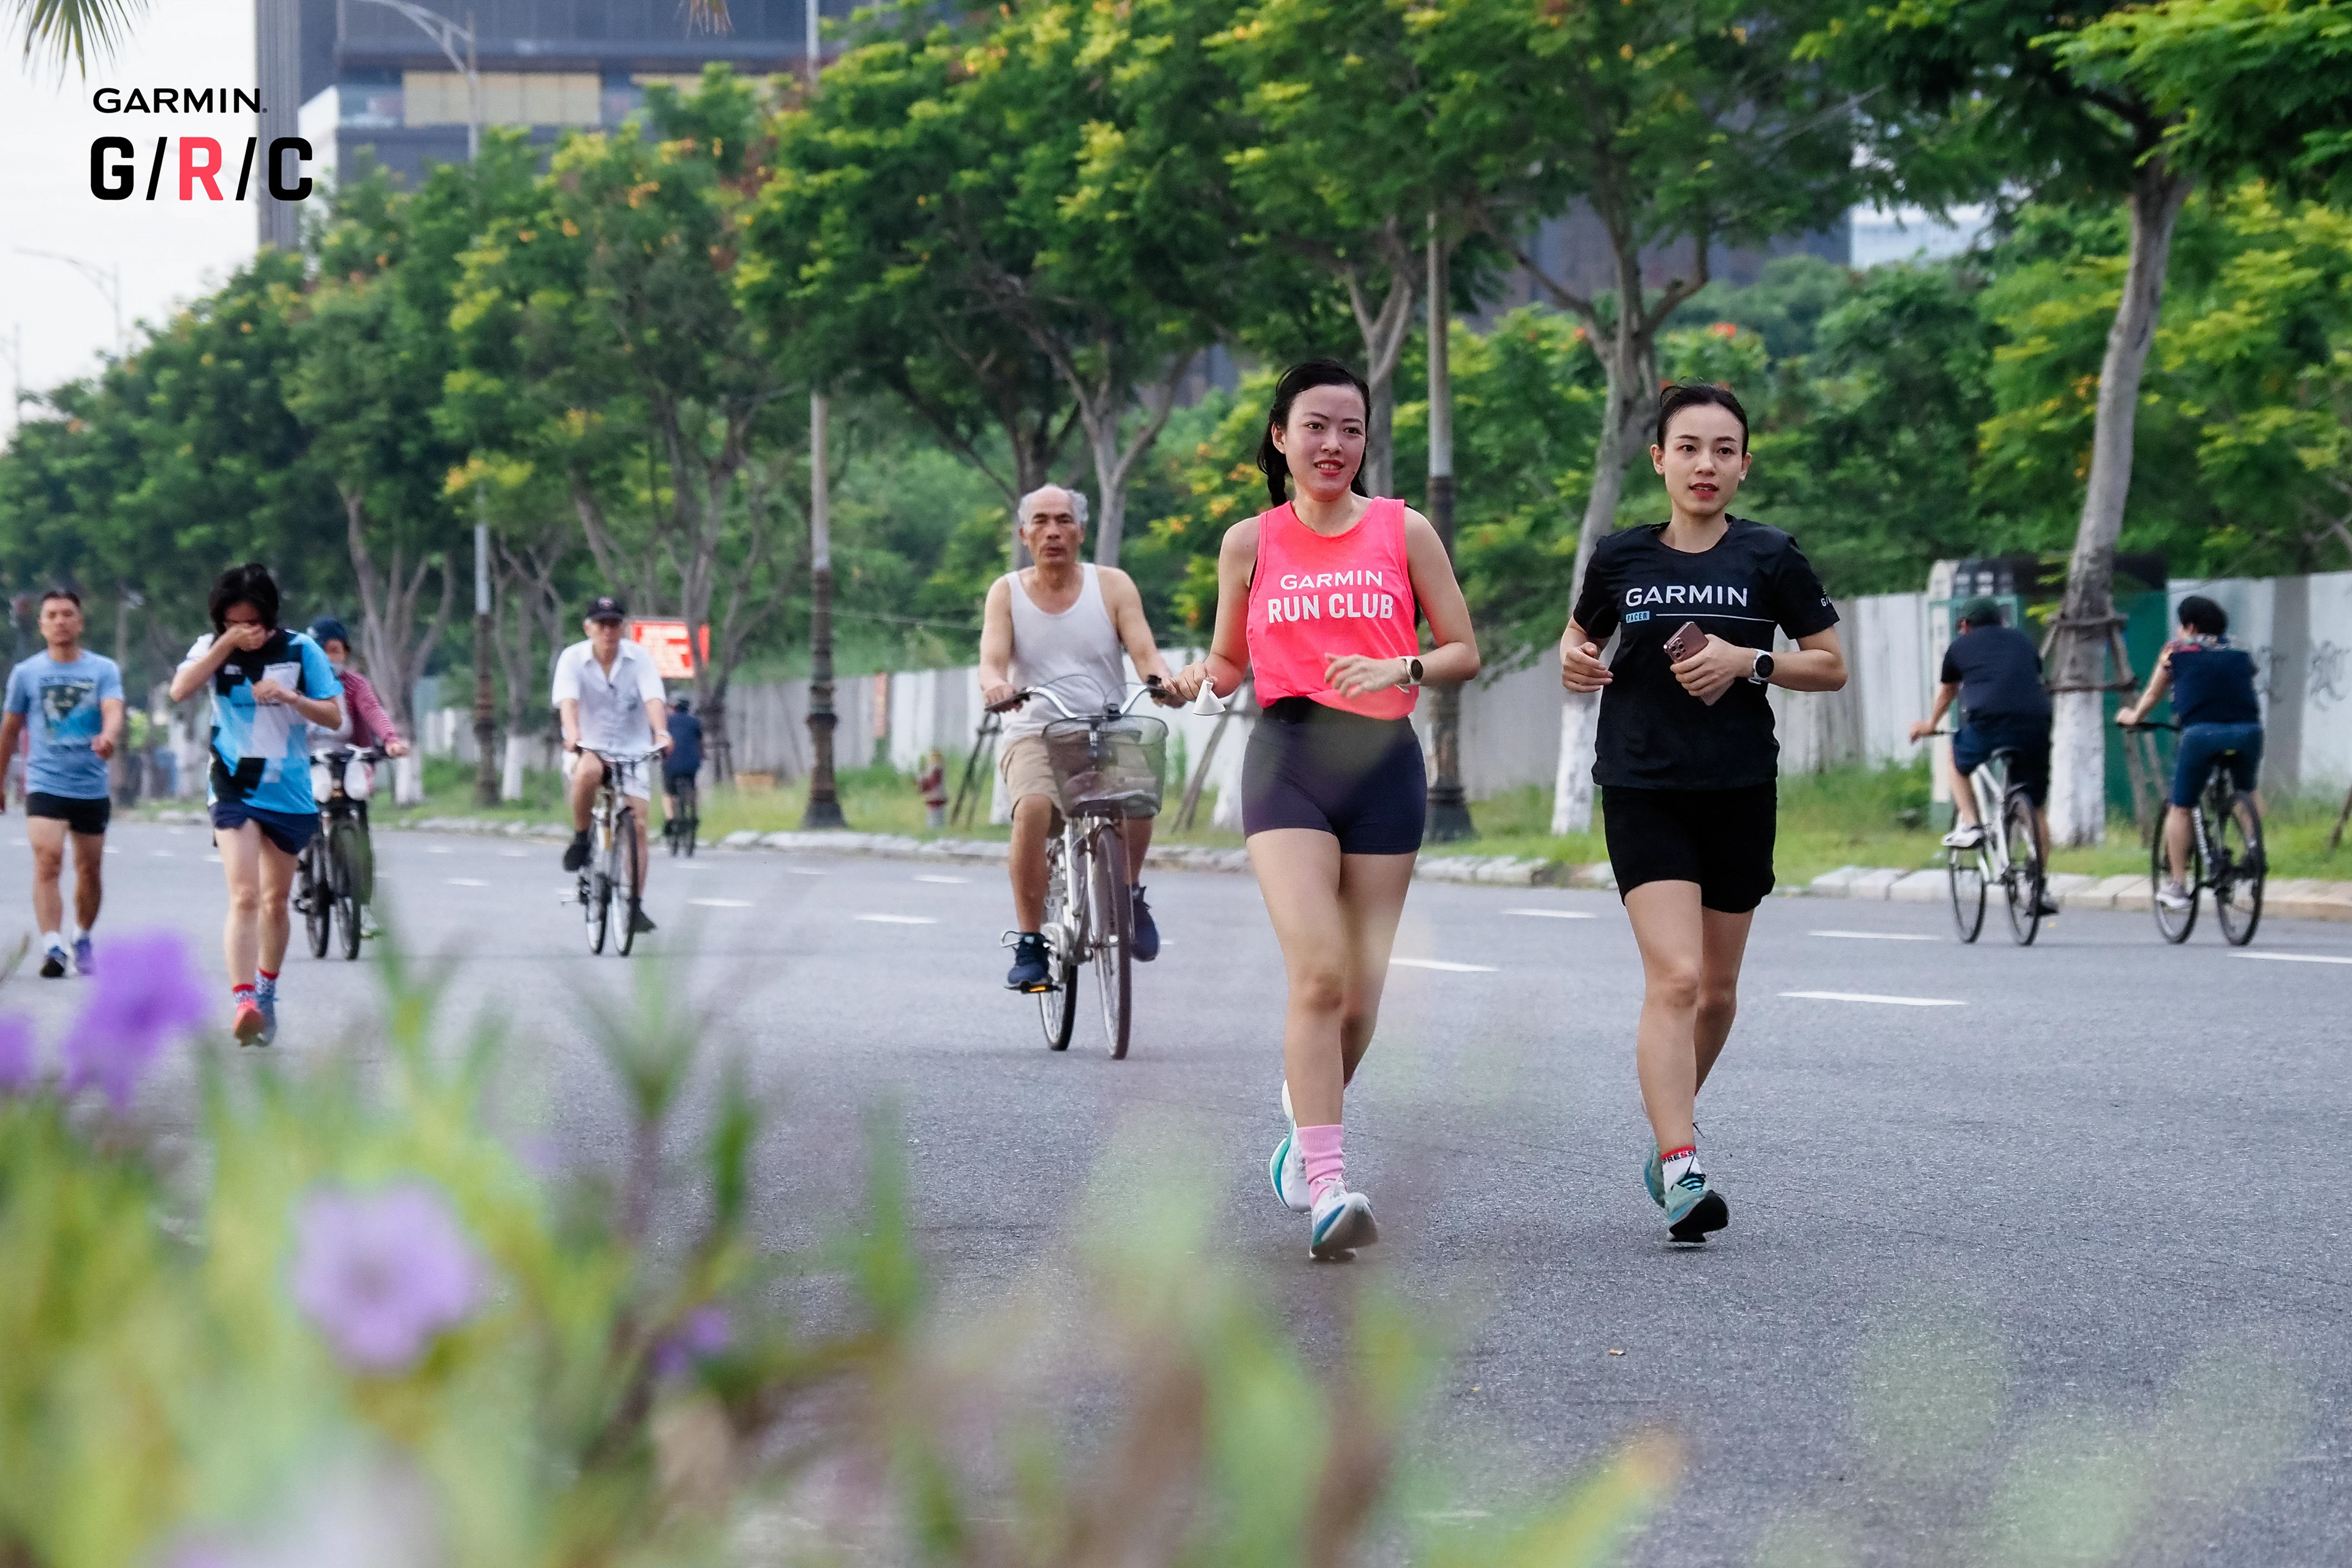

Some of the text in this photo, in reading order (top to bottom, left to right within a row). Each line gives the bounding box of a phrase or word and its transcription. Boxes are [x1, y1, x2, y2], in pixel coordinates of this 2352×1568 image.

[1280, 570, 1382, 590] GARMIN
[1626, 586, 1748, 606] GARMIN
[1268, 593, 1393, 624] RUN CLUB
[1627, 612, 1648, 622] PACER
